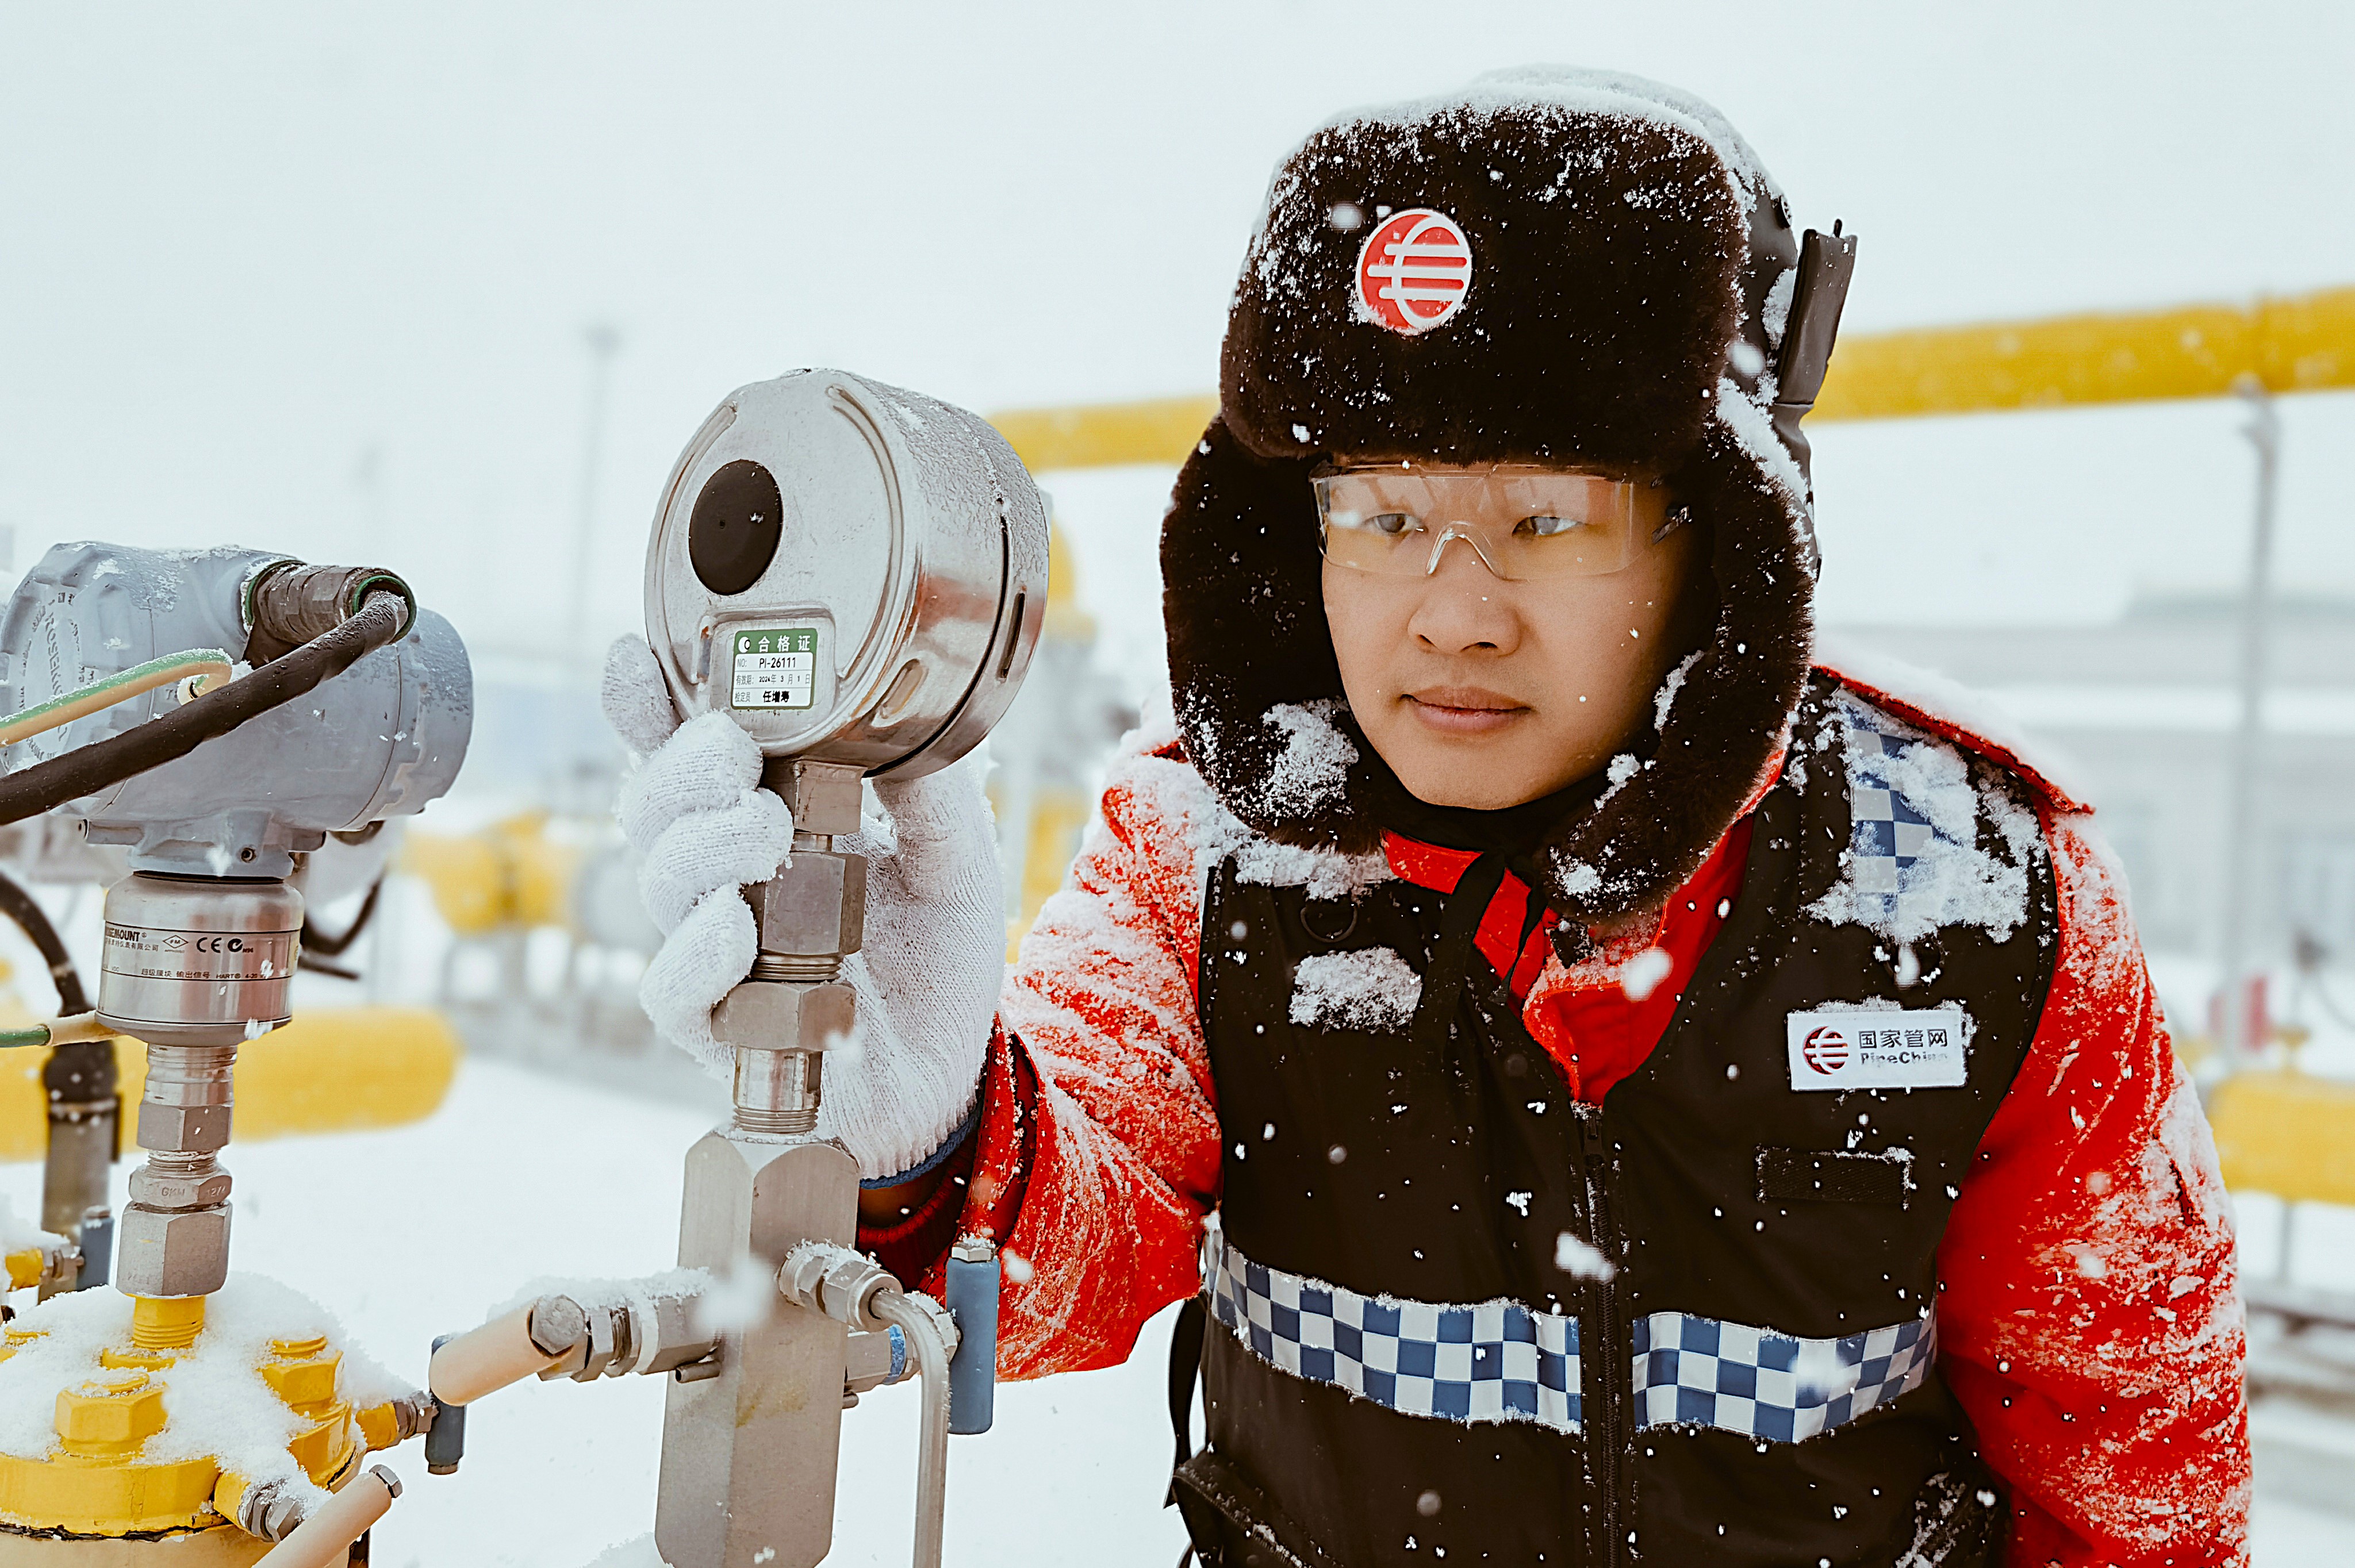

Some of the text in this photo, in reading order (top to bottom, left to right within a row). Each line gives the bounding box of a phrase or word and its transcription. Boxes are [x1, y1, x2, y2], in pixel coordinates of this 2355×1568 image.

[758, 635, 811, 652] 合格证
[759, 657, 796, 668] PI-26111
[1858, 1029, 1948, 1049] 国家管网
